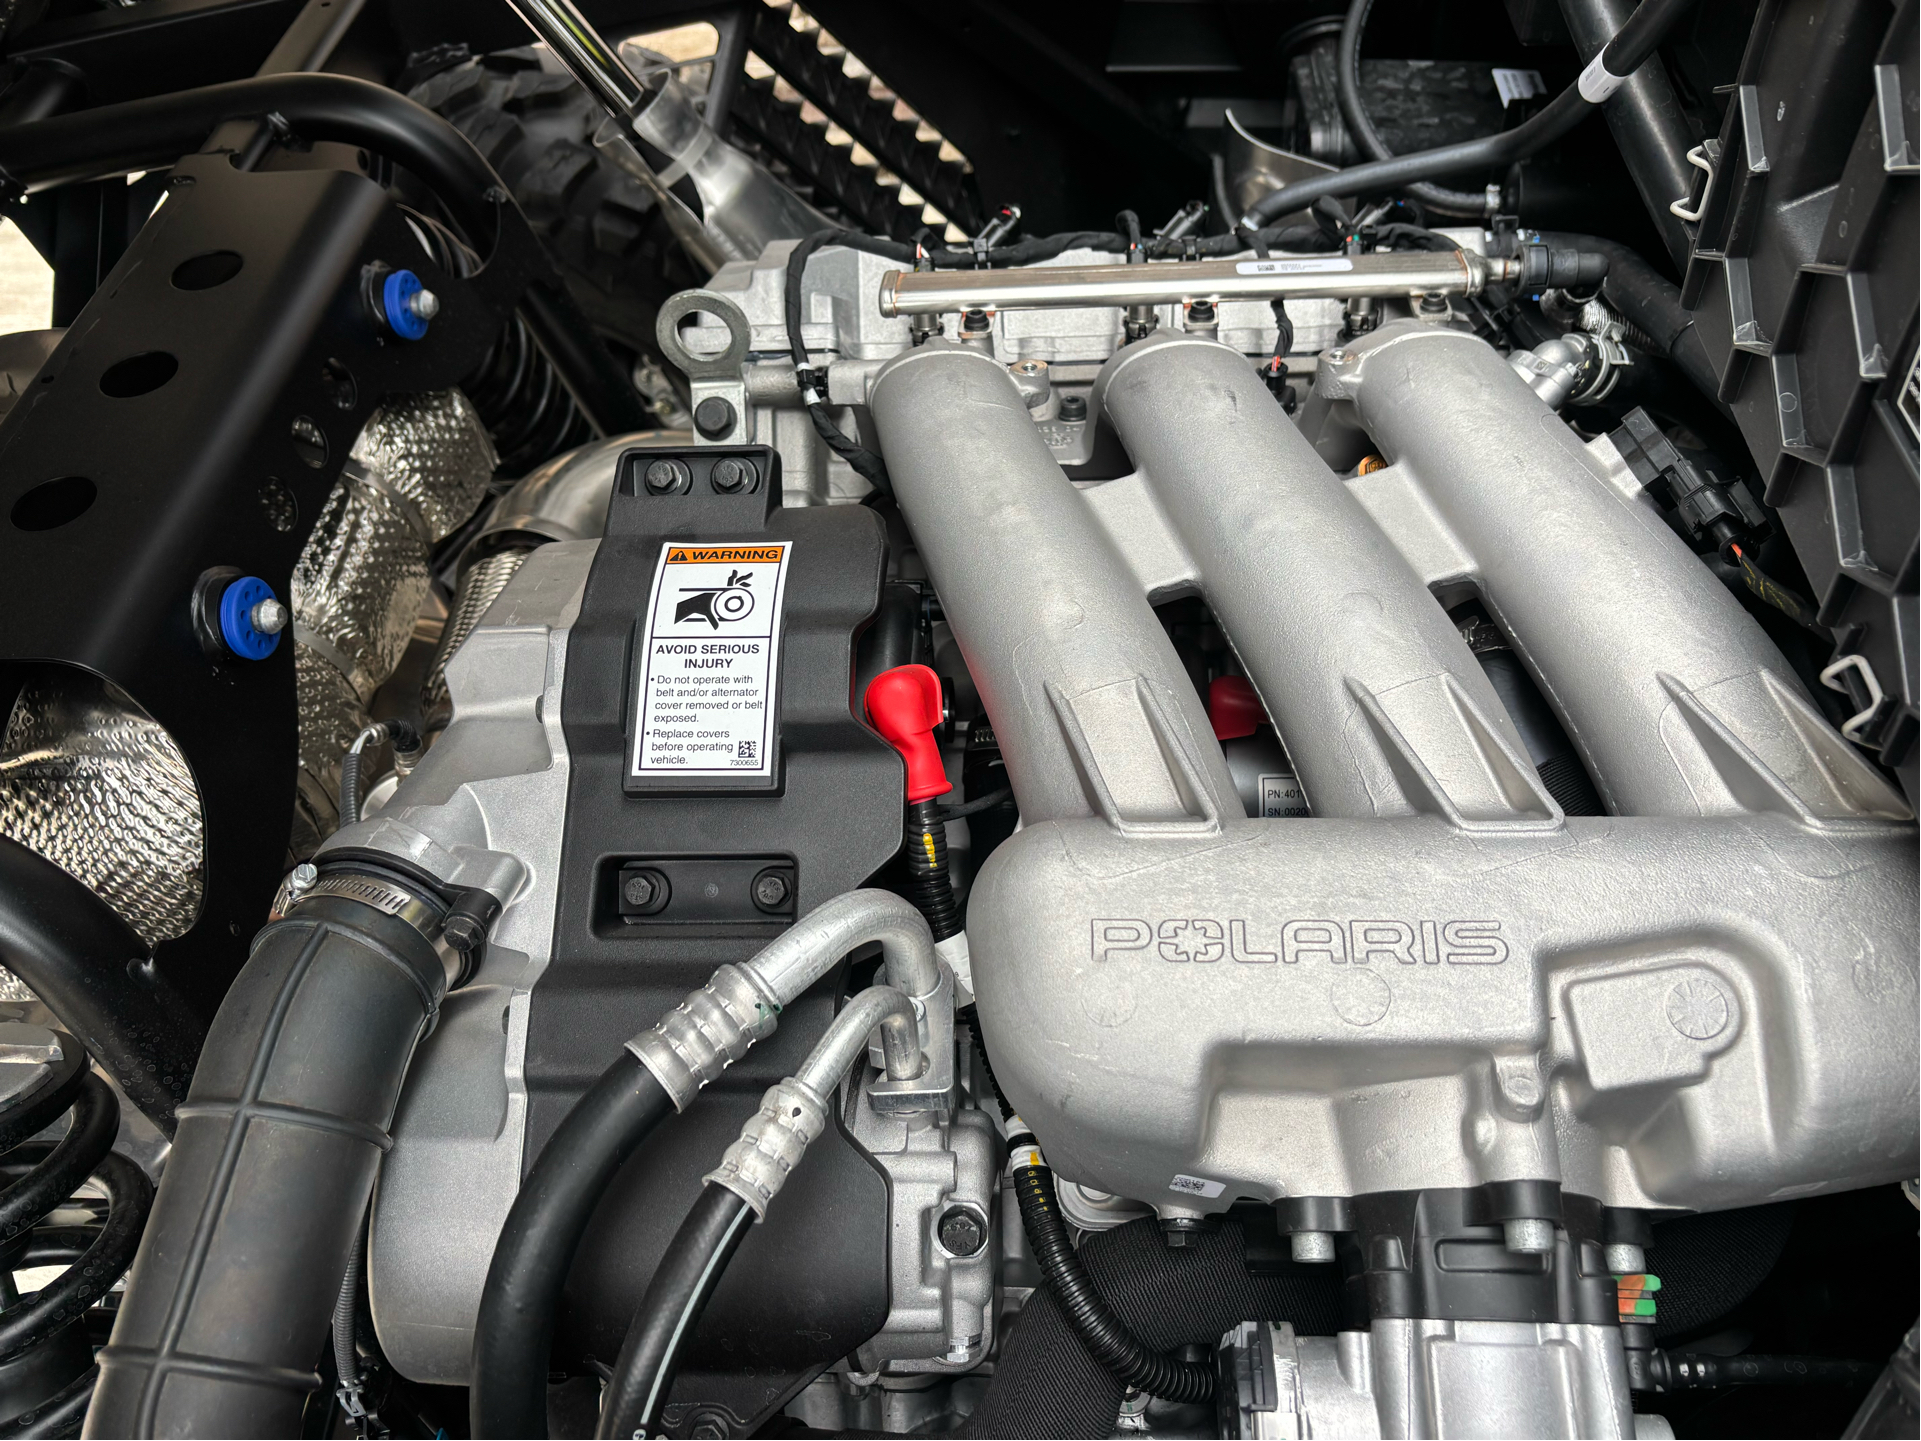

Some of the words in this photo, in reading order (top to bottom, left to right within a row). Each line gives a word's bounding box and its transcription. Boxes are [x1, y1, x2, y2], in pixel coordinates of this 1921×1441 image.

[692, 549, 779, 560] WARNING
[656, 644, 698, 655] AVOID
[700, 644, 760, 655] SERIOUS
[684, 658, 734, 669] INJURY
[657, 675, 672, 684] Do
[674, 675, 690, 684] not
[692, 675, 731, 686] operate
[733, 674, 753, 684] with
[655, 687, 675, 697] belt
[676, 687, 709, 697] and/or
[711, 687, 759, 697] alternator
[654, 701, 683, 710] cover
[685, 700, 729, 710] removed
[731, 701, 743, 710] or
[744, 700, 763, 710] belt
[653, 713, 699, 724] exposed.
[652, 728, 694, 740] Replace
[696, 730, 730, 739] covers
[651, 741, 684, 751] before
[686, 741, 734, 753] operating
[650, 755, 689, 765] vehicle.
[729, 759, 759, 767] 7300655
[1267, 807, 1308, 817] SN:0020
[1091, 918, 1510, 965] POLARIS
